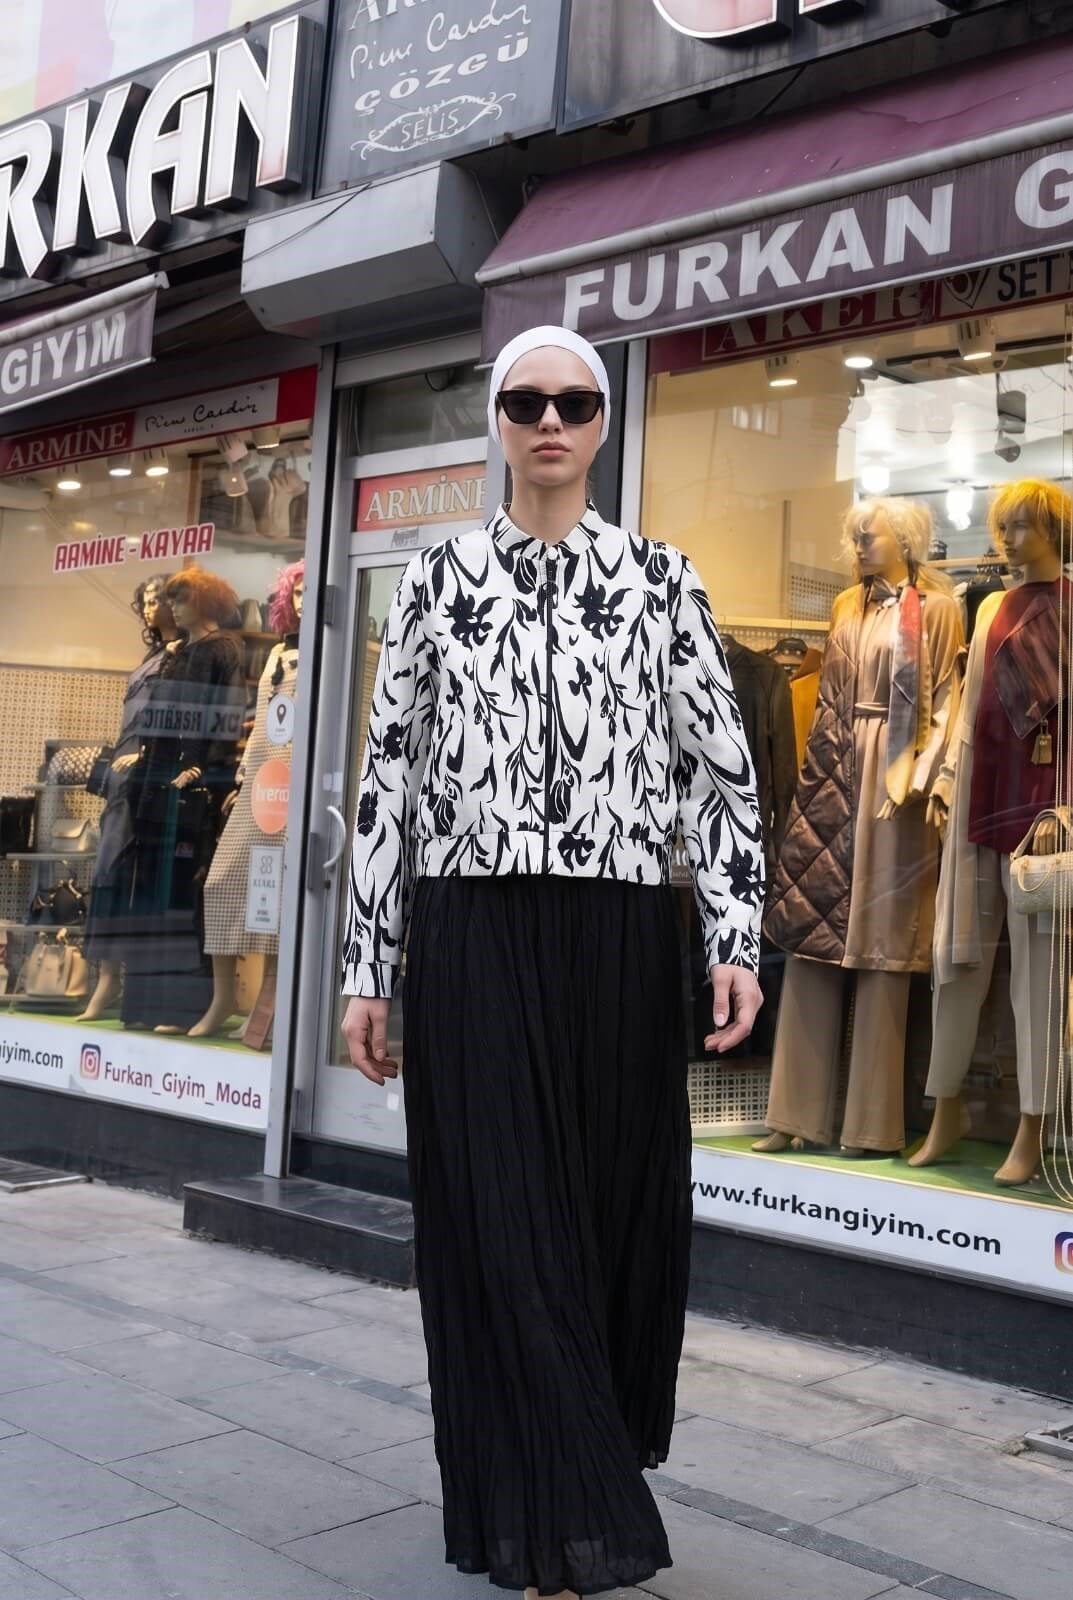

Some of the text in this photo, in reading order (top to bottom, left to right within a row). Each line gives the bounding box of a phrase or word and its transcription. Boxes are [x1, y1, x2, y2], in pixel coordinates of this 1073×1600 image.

[355, 32, 529, 116] ÇÖZGÜ
[563, 183, 954, 331] FURKAN
[6, 421, 127, 471] ARMİNE
[0, 1040, 63, 1069] iyim.com
[104, 1062, 262, 1109] Furkan_Giyim_Moda
